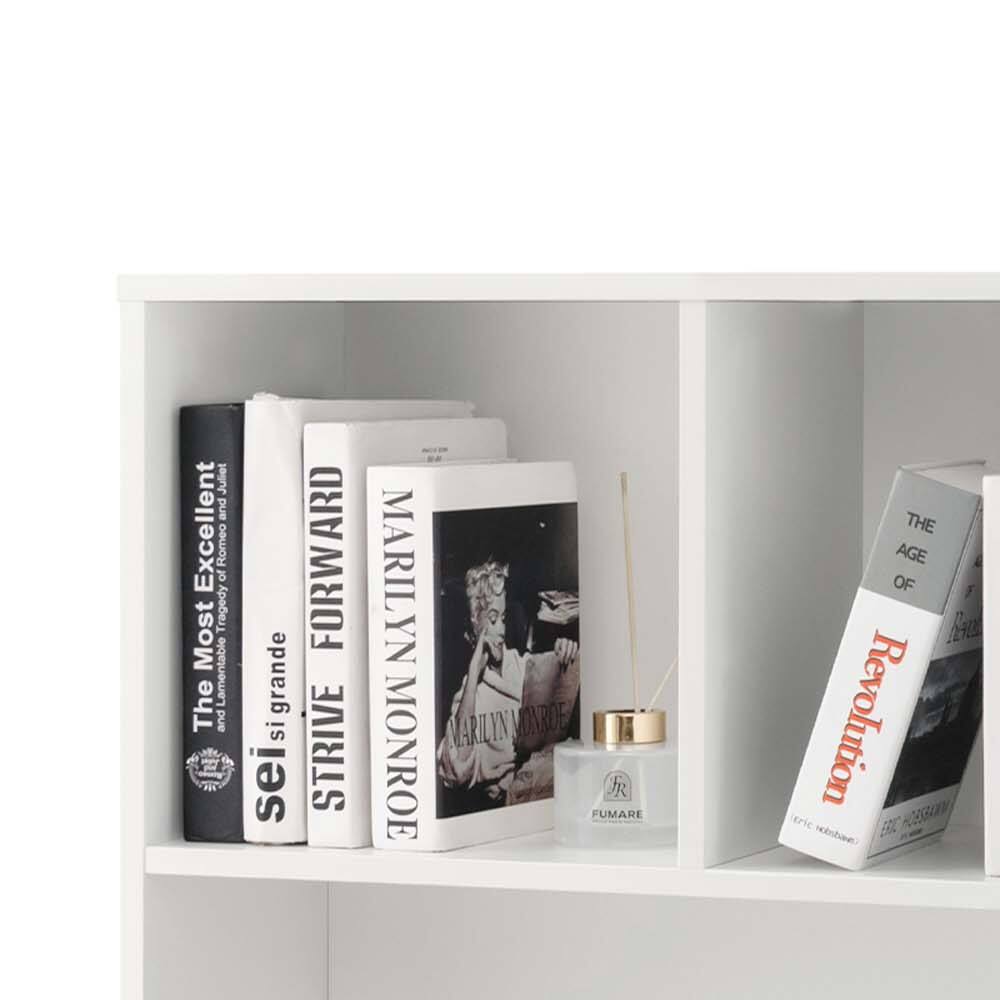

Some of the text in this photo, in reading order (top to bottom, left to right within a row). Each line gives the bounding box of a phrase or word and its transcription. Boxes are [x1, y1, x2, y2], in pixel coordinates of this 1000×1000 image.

[193, 461, 215, 733] The Most Excellent
[216, 463, 228, 733] and Lamentable Tragedy of Romeo and Juliet
[893, 574, 916, 592] OF
[896, 542, 928, 565] AGE
[907, 511, 937, 535] THE
[250, 632, 291, 823] sei si grande
[309, 466, 345, 811] STRIVE FORWARD
[383, 489, 419, 840] MARILYN MONROE
[449, 701, 568, 749] MARILYN MONROE
[823, 628, 908, 807] Revolution
[592, 809, 643, 819] FUMARE
